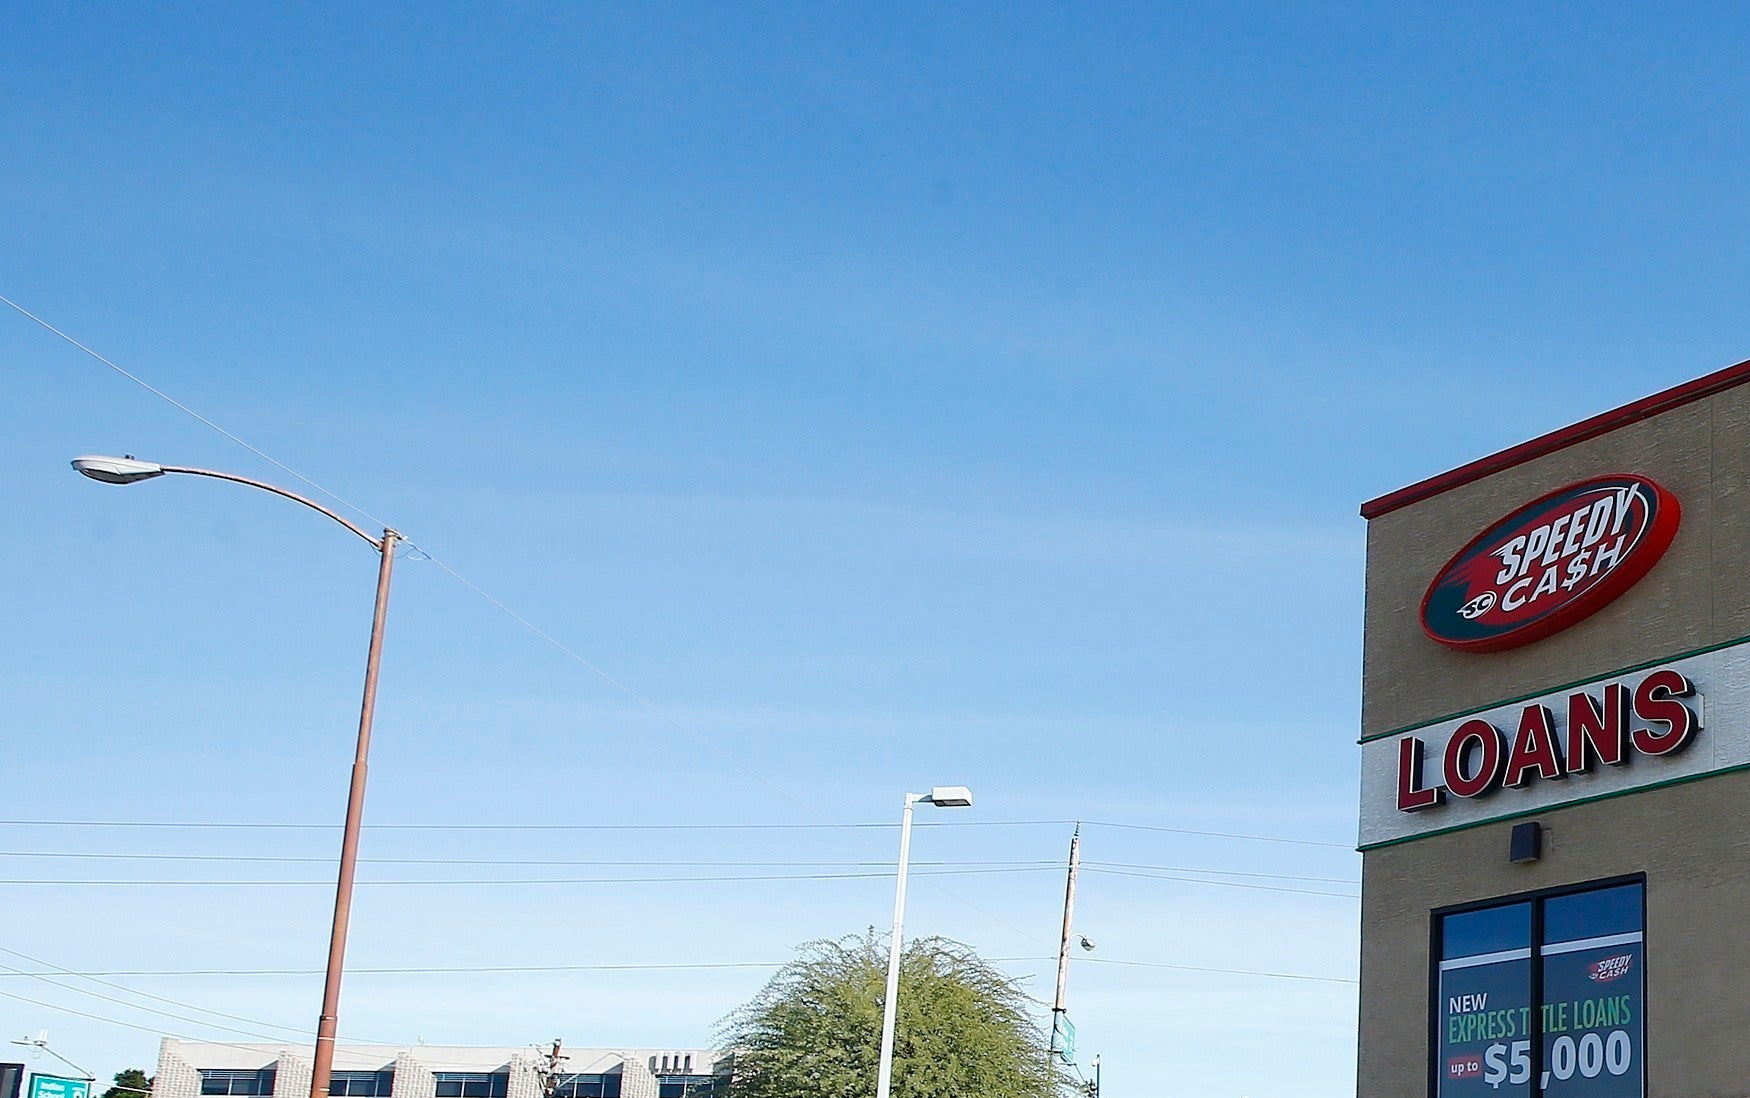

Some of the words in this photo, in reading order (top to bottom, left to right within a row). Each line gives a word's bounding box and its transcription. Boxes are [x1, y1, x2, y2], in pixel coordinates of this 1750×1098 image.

[1490, 482, 1641, 585] SPEEDY
[1395, 668, 1696, 812] LOANS
[1597, 954, 1632, 972] SPEEDY
[1448, 1009, 1516, 1044] EXPRESS
[1519, 1002, 1568, 1036] TTLE
[1573, 994, 1631, 1031] LOANS
[1449, 993, 1487, 1014] NEW
[1451, 1062, 1465, 1076] up
[1467, 1061, 1479, 1073] to
[1484, 1030, 1632, 1089] $5,000
[40, 1082, 66, 1092] Indian
